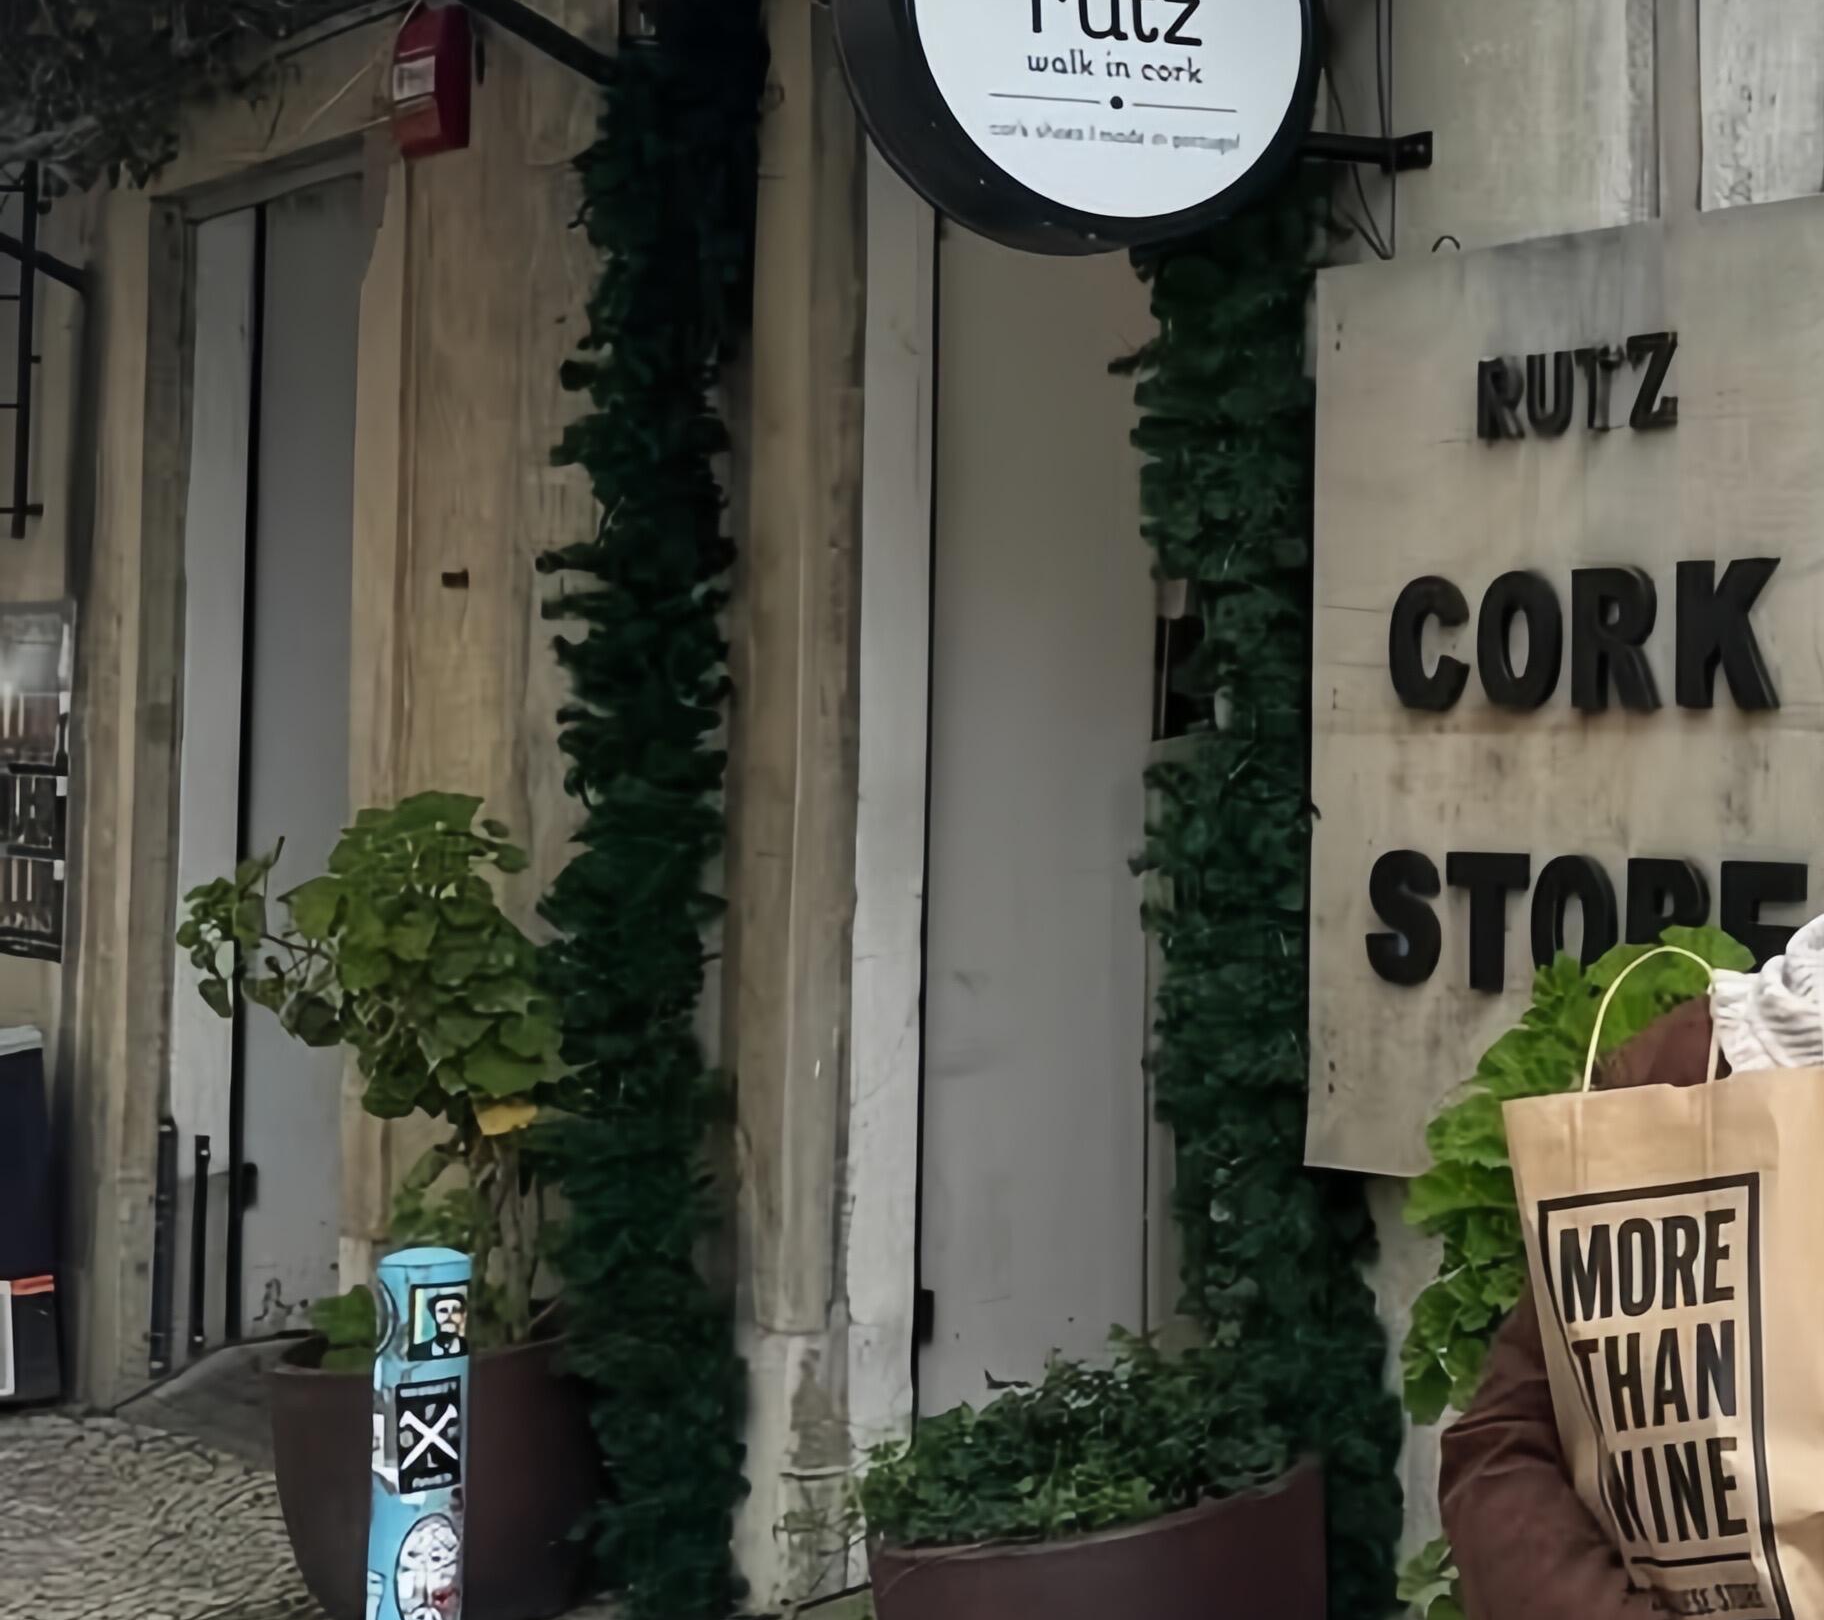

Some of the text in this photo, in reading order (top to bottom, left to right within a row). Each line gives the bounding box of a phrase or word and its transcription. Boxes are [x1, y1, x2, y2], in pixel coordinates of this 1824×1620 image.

[1027, 48, 1204, 84] walk in cork
[1477, 330, 1679, 442] RUTZ
[1388, 556, 1782, 713] CORK
[1558, 1208, 1737, 1324] MORE
[1571, 1318, 1737, 1434] THAN
